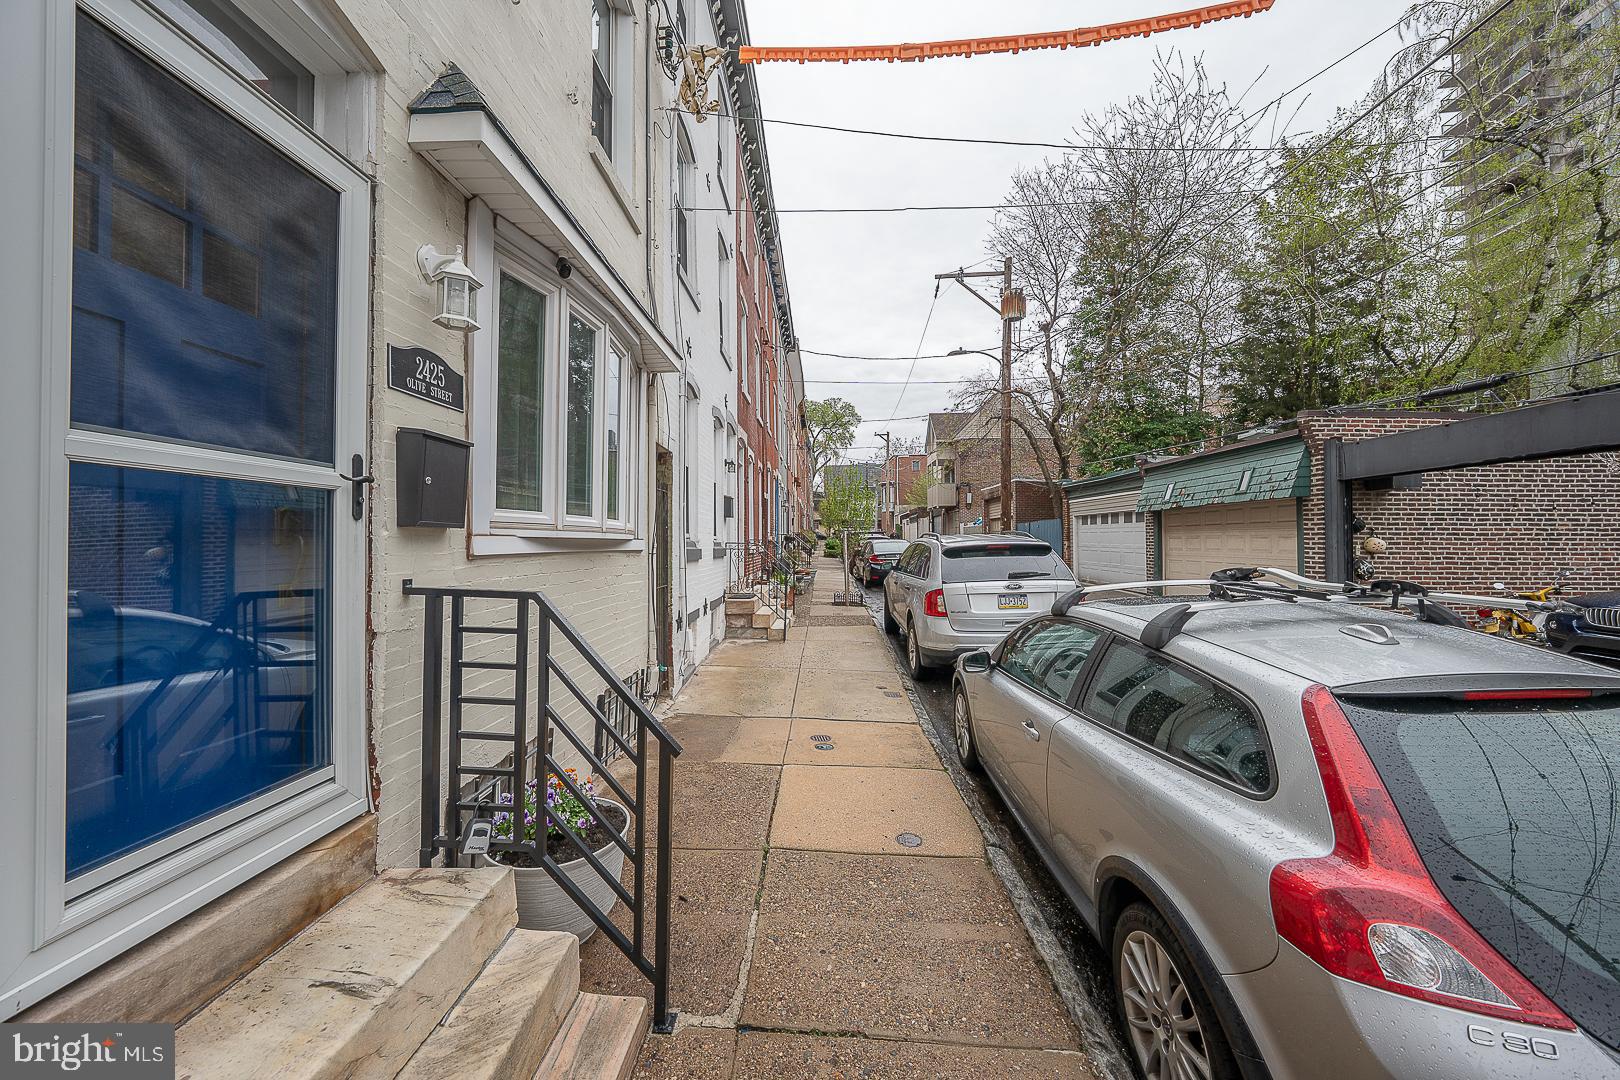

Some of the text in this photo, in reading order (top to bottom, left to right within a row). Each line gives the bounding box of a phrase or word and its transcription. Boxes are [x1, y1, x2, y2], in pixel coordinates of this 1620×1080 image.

[415, 356, 445, 387] 2425
[406, 377, 453, 403] OLIVE STREET
